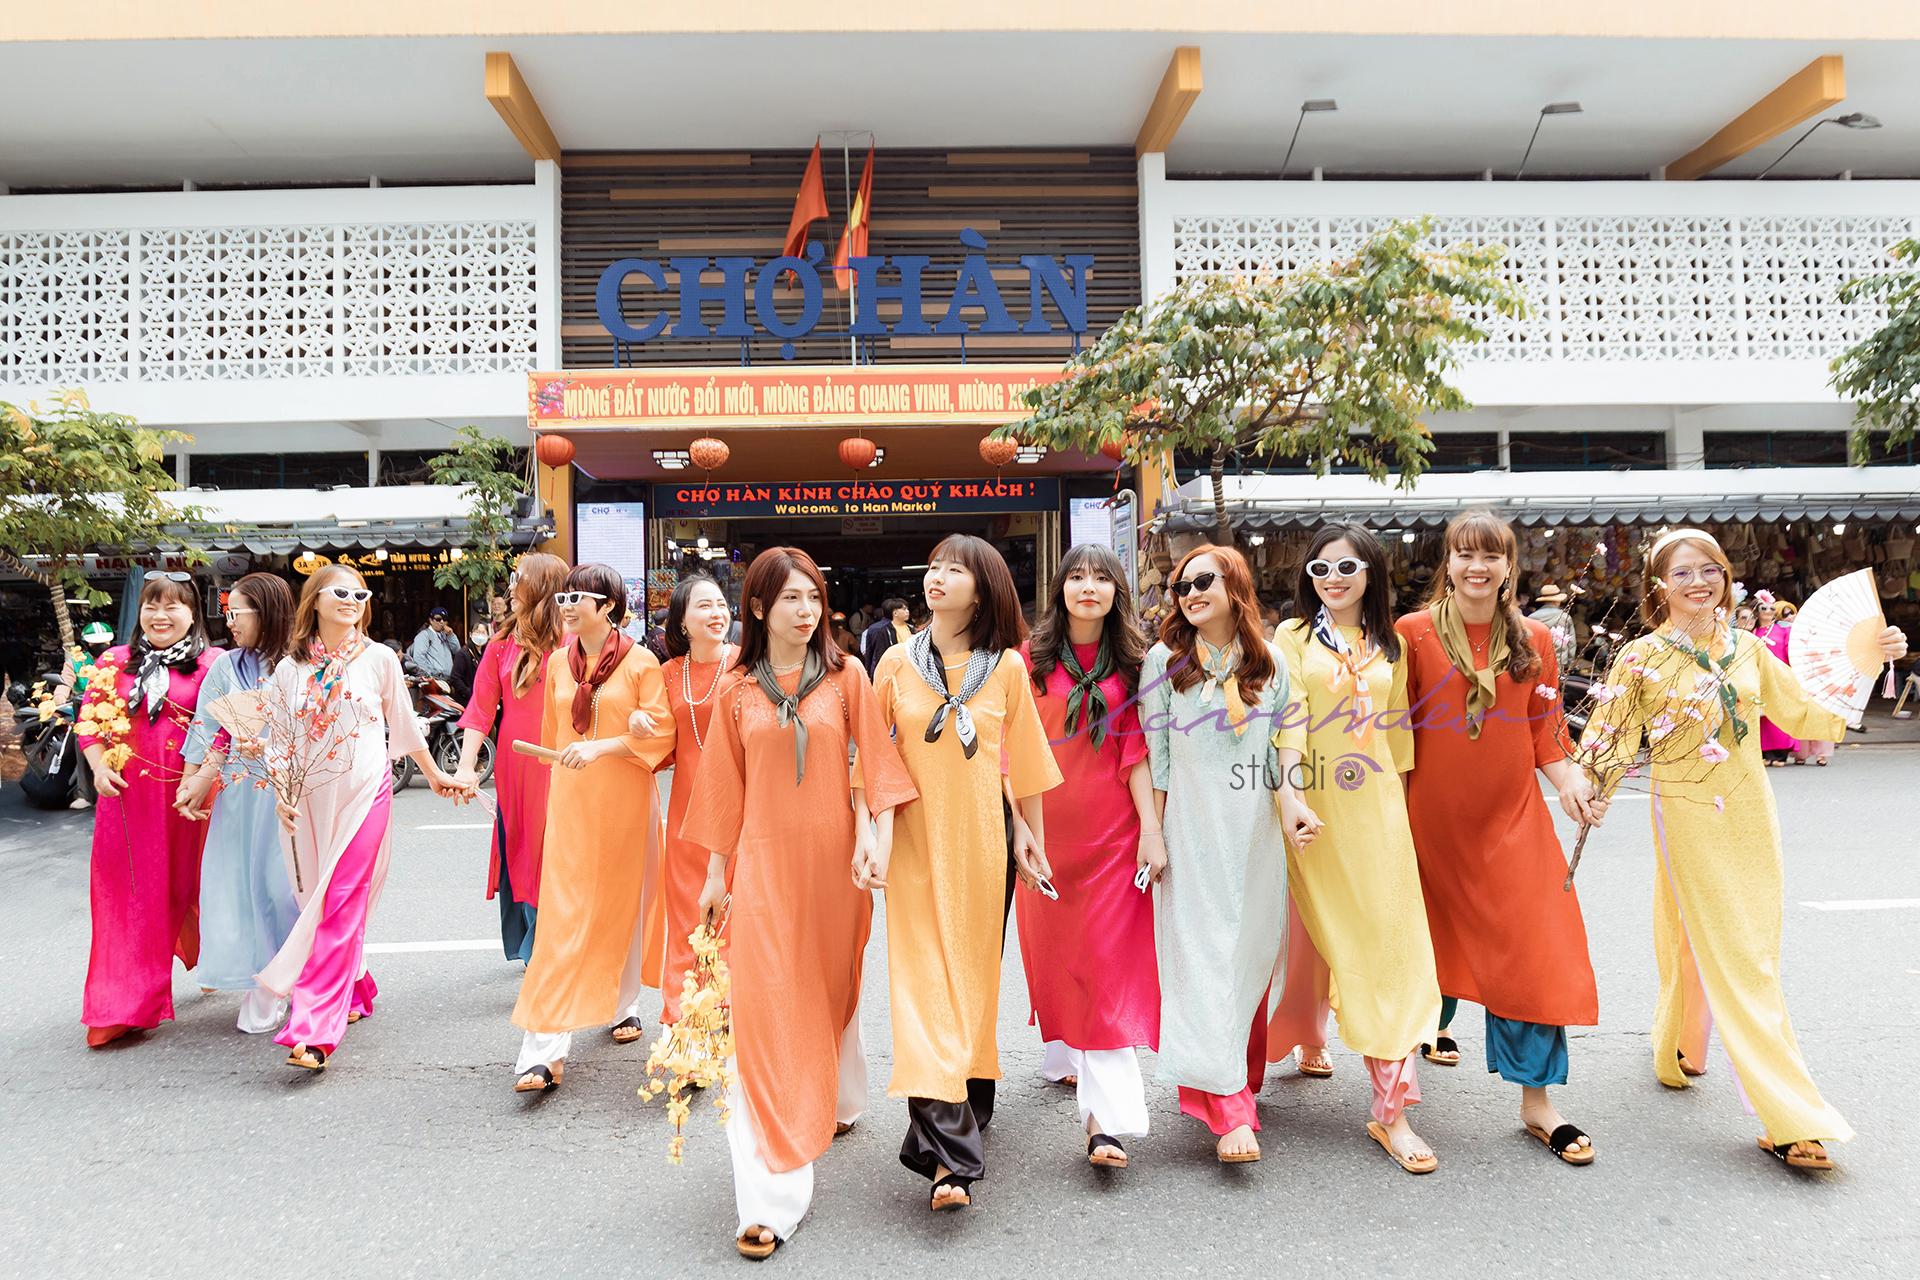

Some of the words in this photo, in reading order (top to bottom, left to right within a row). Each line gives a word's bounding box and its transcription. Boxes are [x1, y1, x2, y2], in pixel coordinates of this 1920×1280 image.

[596, 241, 826, 360] CHỢ
[848, 227, 1094, 335] HÀN
[563, 383, 609, 417] MỪNG
[614, 378, 643, 416] ĐẤT
[648, 380, 690, 416] NƯỚC
[694, 376, 720, 415] ĐỔI
[724, 380, 759, 417] MỚI,
[763, 379, 809, 415] MỪNG
[813, 375, 855, 414] ĐẢNG
[859, 383, 910, 414] QUANG
[913, 383, 954, 414] VINH,
[958, 378, 1003, 411] MỪNG
[676, 486, 721, 506] CHỢ
[726, 484, 771, 501] HÀN
[778, 482, 832, 500] KÍNH
[837, 482, 893, 500] CHÀO
[900, 481, 943, 500] QUÝ
[949, 480, 1023, 498] KHÁCH
[775, 504, 839, 514] Welcome
[845, 503, 859, 513] to
[863, 502, 889, 513] Han
[891, 501, 937, 512] Market
